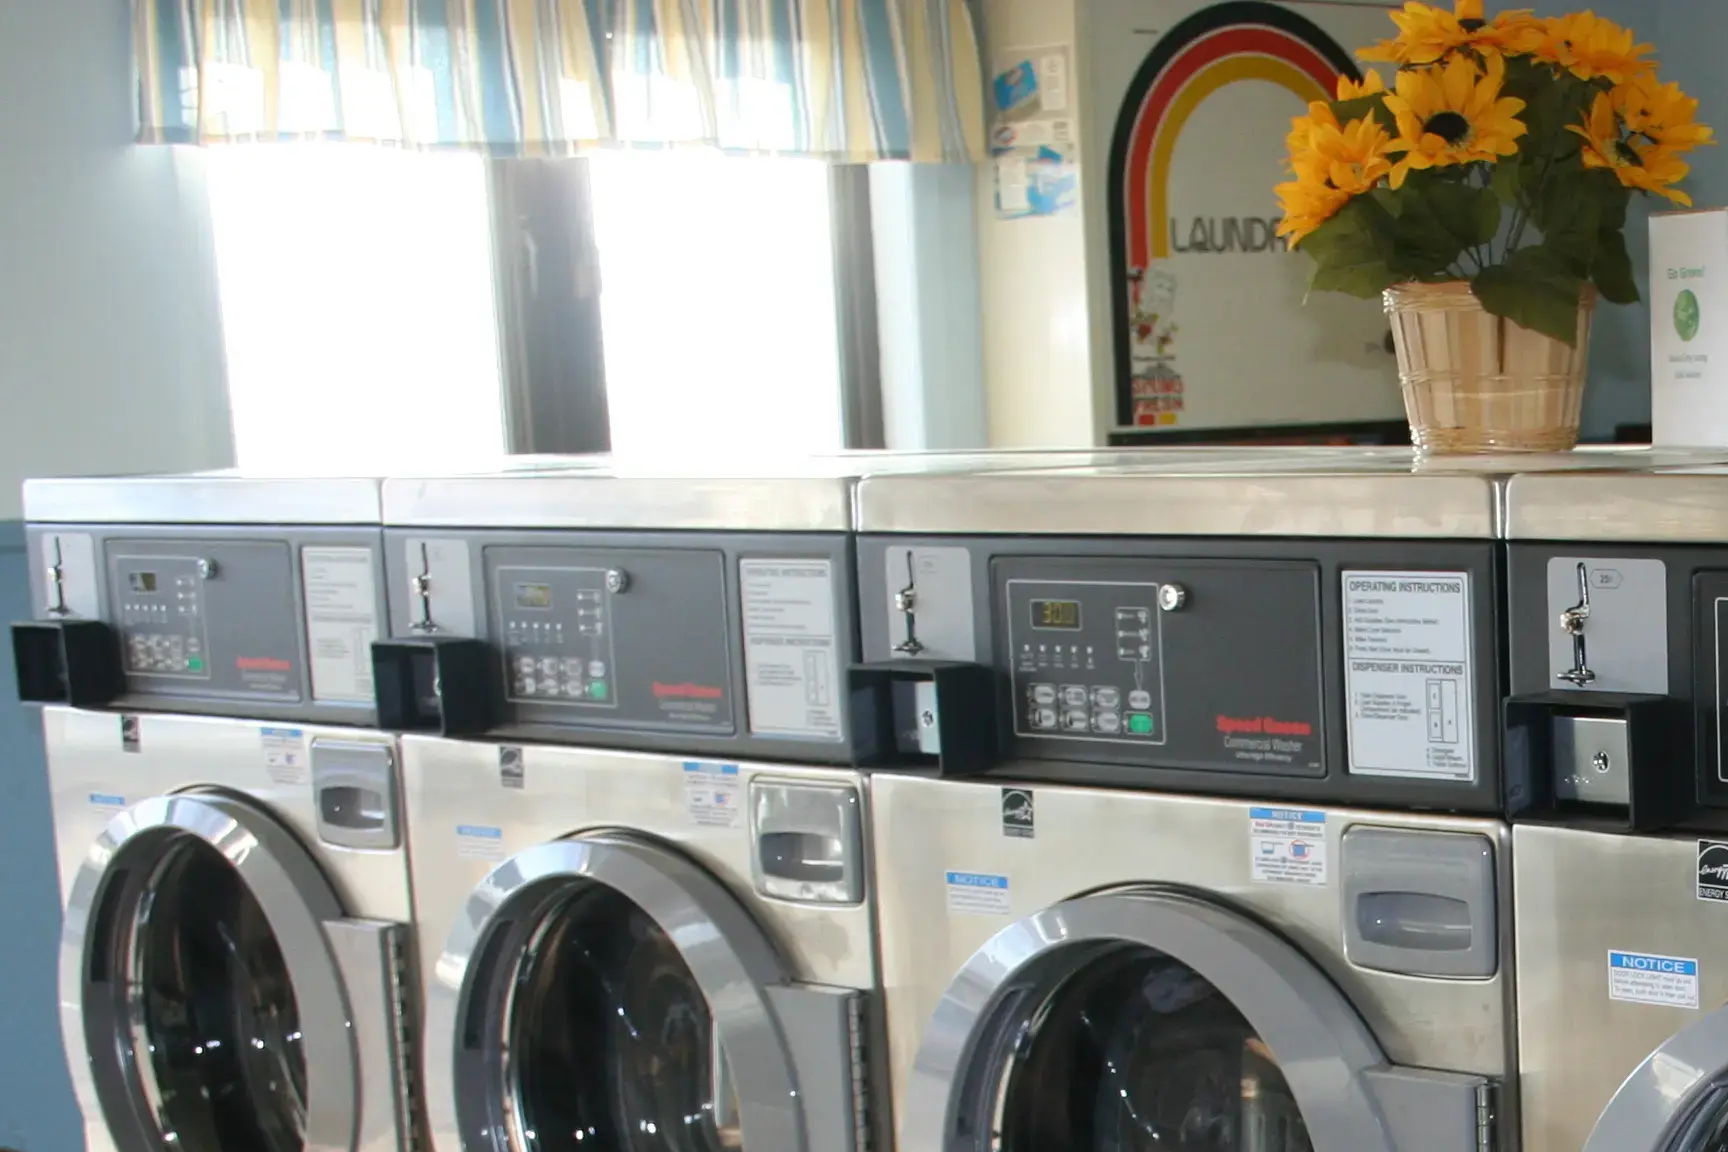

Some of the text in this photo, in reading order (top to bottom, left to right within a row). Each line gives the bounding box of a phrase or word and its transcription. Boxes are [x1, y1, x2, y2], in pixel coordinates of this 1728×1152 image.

[1171, 217, 1300, 254] LAUNDR
[1350, 581, 1460, 593] OPERATING INSTRUCTIONS
[1353, 662, 1463, 675] DISPENSER INSTRUCTIONS
[1700, 888, 1724, 898] ENERGY
[1622, 956, 1685, 973] NOTICE
